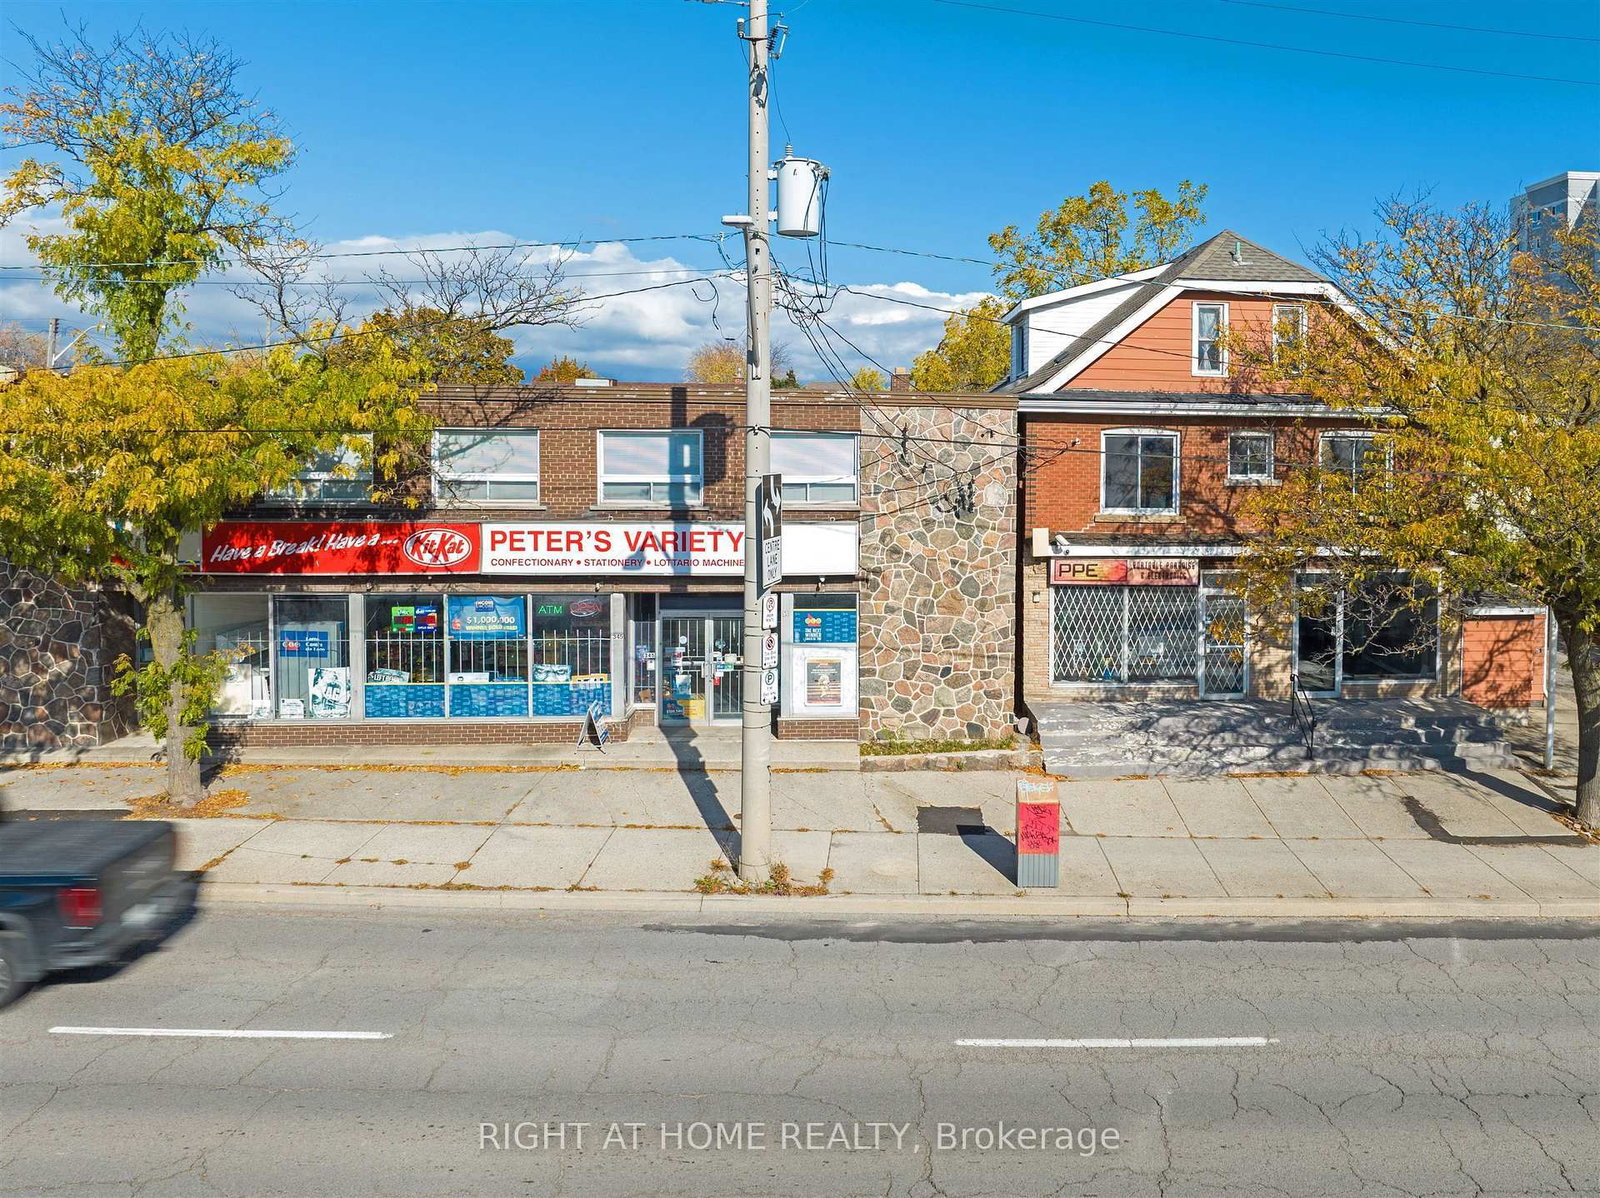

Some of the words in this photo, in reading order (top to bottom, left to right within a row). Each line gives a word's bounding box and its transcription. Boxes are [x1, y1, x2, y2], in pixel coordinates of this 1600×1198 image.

[210, 545, 252, 562] Have
[253, 544, 268, 558] a
[267, 535, 326, 557] Break!
[325, 533, 366, 551] Have
[490, 530, 612, 552] PETER'S
[623, 530, 745, 552] VARIETY
[765, 539, 780, 554] CENTRE
[490, 558, 574, 567] CONFECTIONARY
[584, 558, 643, 567] STATIONERY
[654, 558, 700, 567] LOTTARIO
[767, 553, 778, 567] LANE
[767, 566, 778, 581] ONLY
[1058, 563, 1099, 578] PPE
[537, 605, 563, 614] ATM
